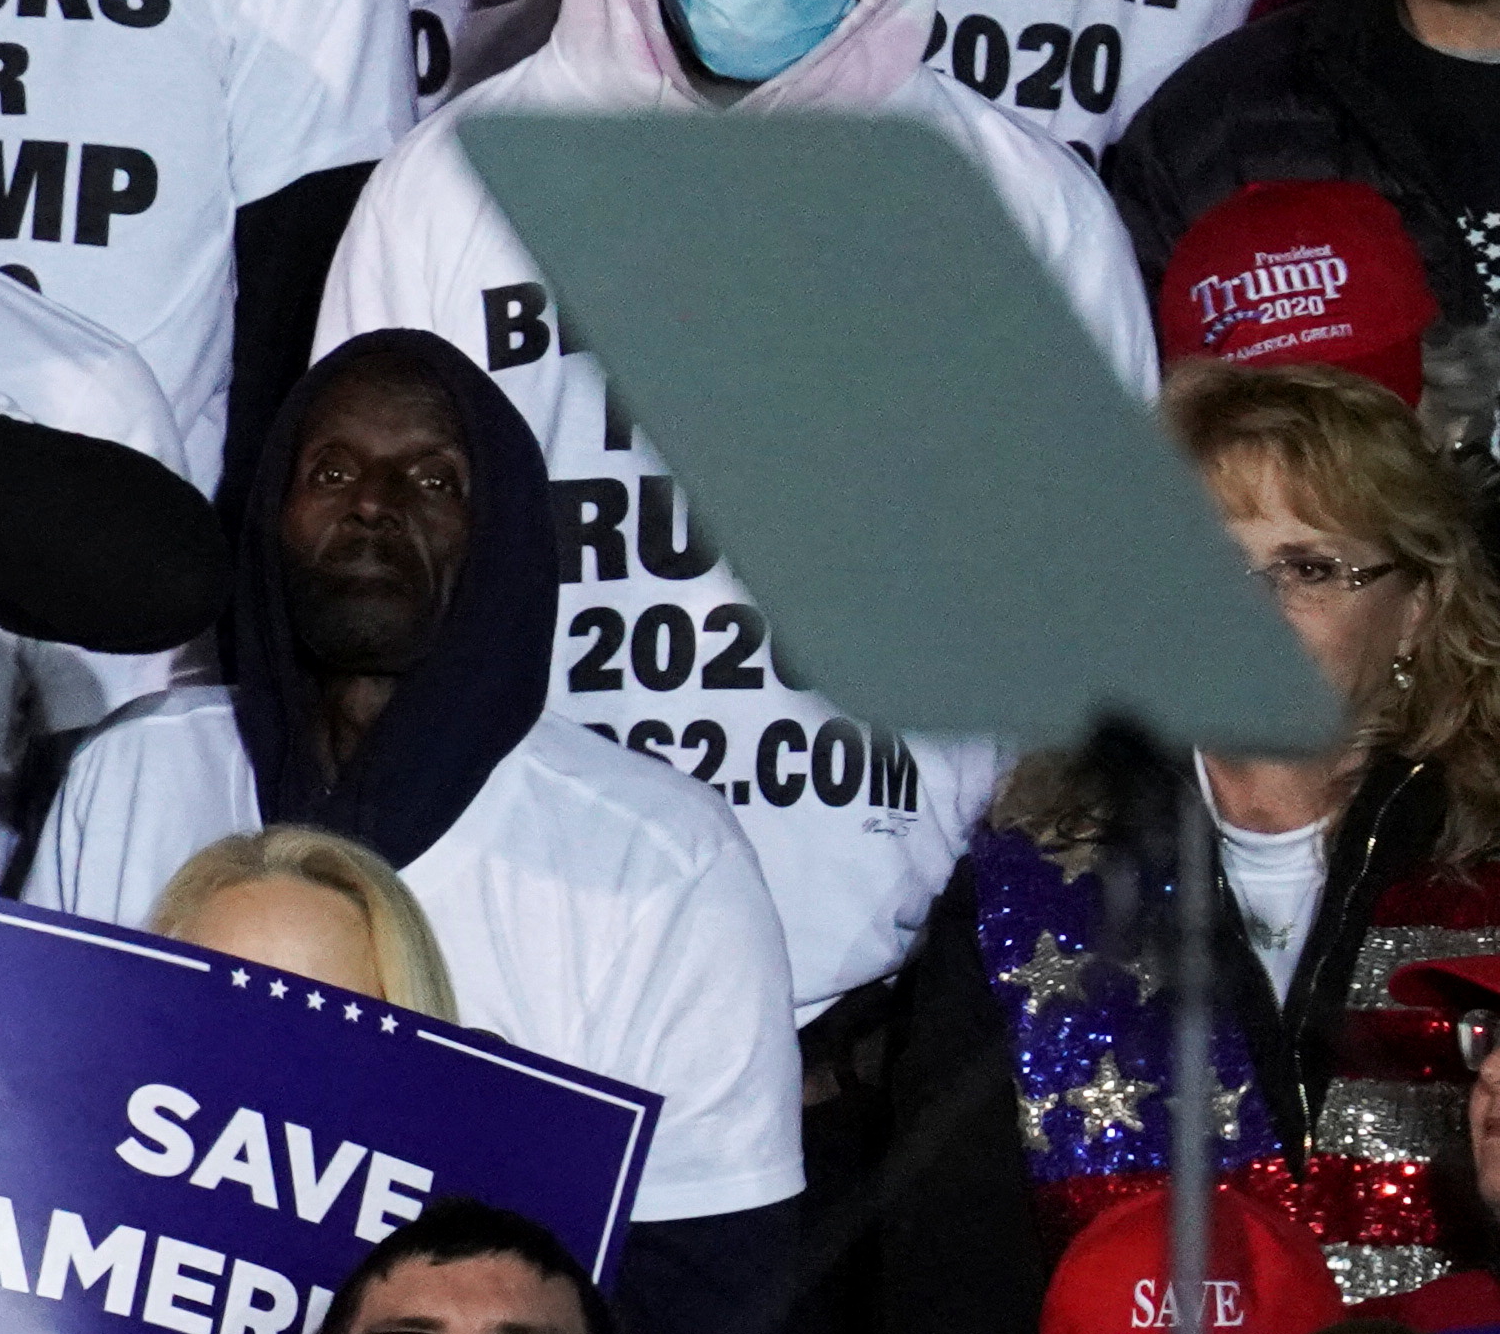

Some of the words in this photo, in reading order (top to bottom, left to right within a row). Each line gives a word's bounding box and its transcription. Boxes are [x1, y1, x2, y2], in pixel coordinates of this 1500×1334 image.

[1190, 259, 1348, 323] Trump
[1258, 297, 1326, 327] 2020
[1235, 335, 1299, 360] AMERICA
[116, 1083, 434, 1245] SAVE
